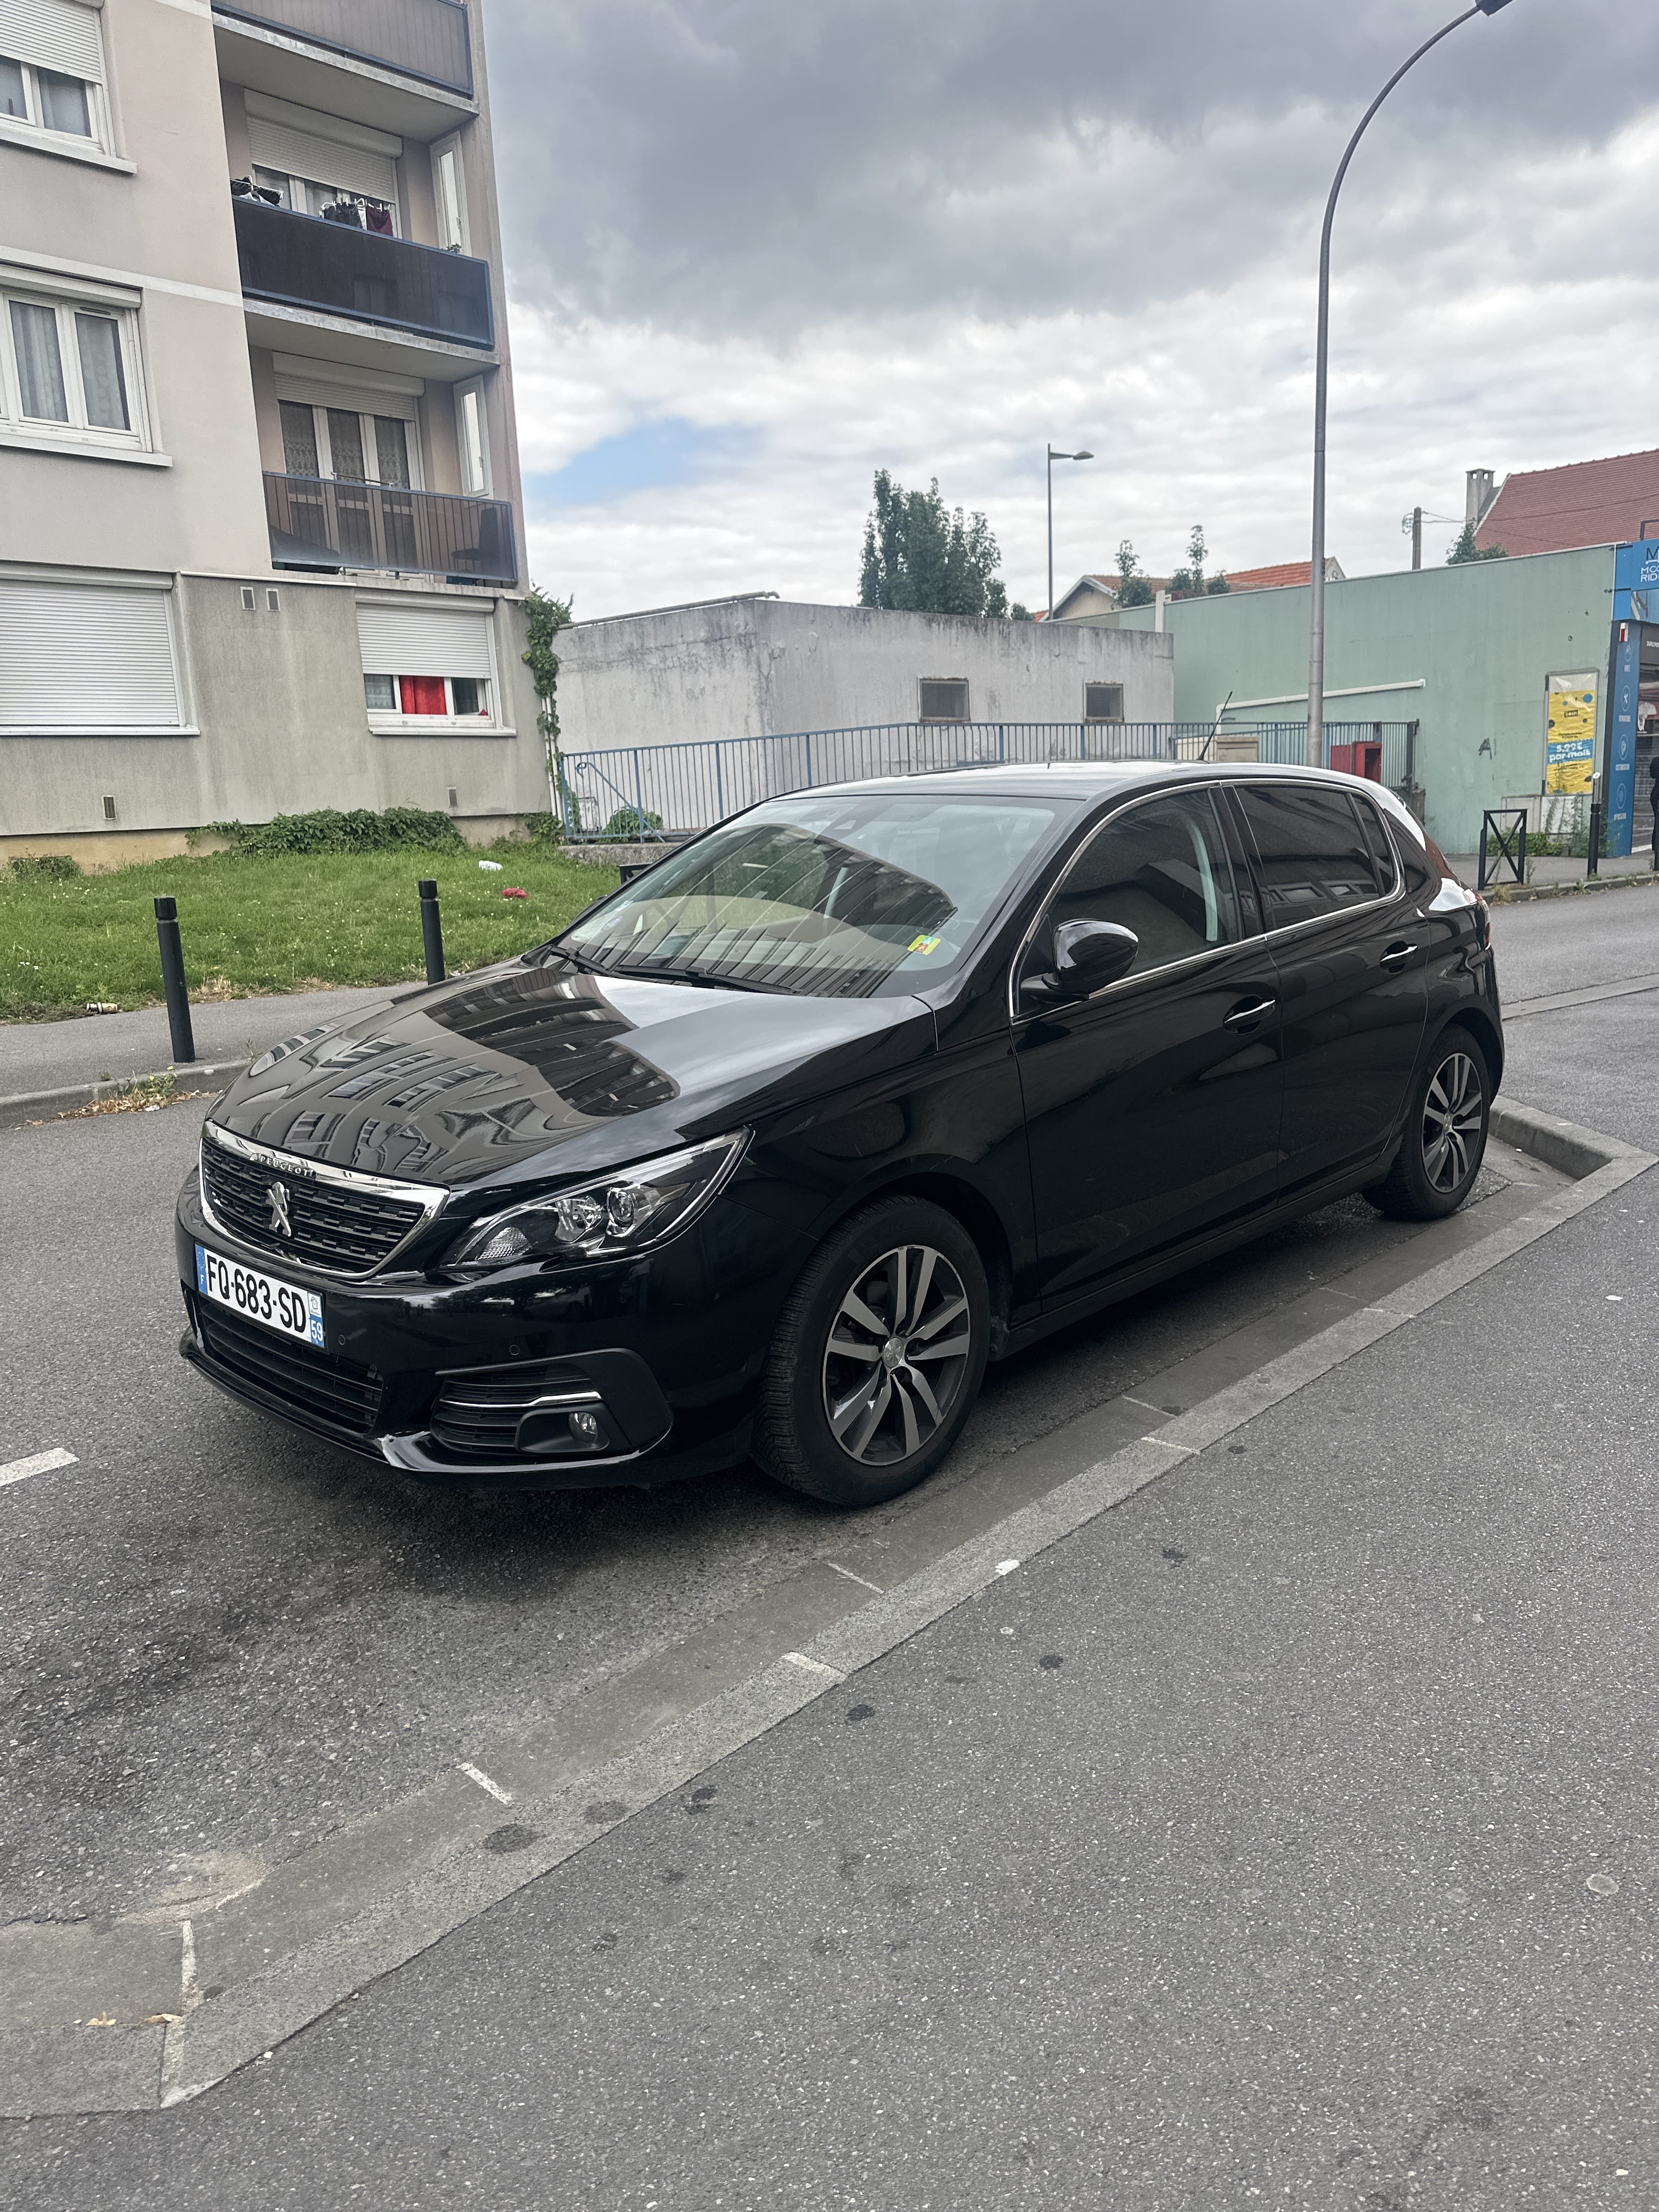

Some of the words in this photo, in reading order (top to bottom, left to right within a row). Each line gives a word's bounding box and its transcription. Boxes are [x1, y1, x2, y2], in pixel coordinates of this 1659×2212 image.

[1641, 573, 1659, 582] RID
[1549, 753, 1566, 763] par
[1567, 749, 1591, 758] mois
[260, 1154, 309, 1176] PEUGEOT
[200, 1274, 205, 1285] F
[207, 1254, 306, 1333] FQ-683-SD
[311, 1319, 324, 1342] 59
